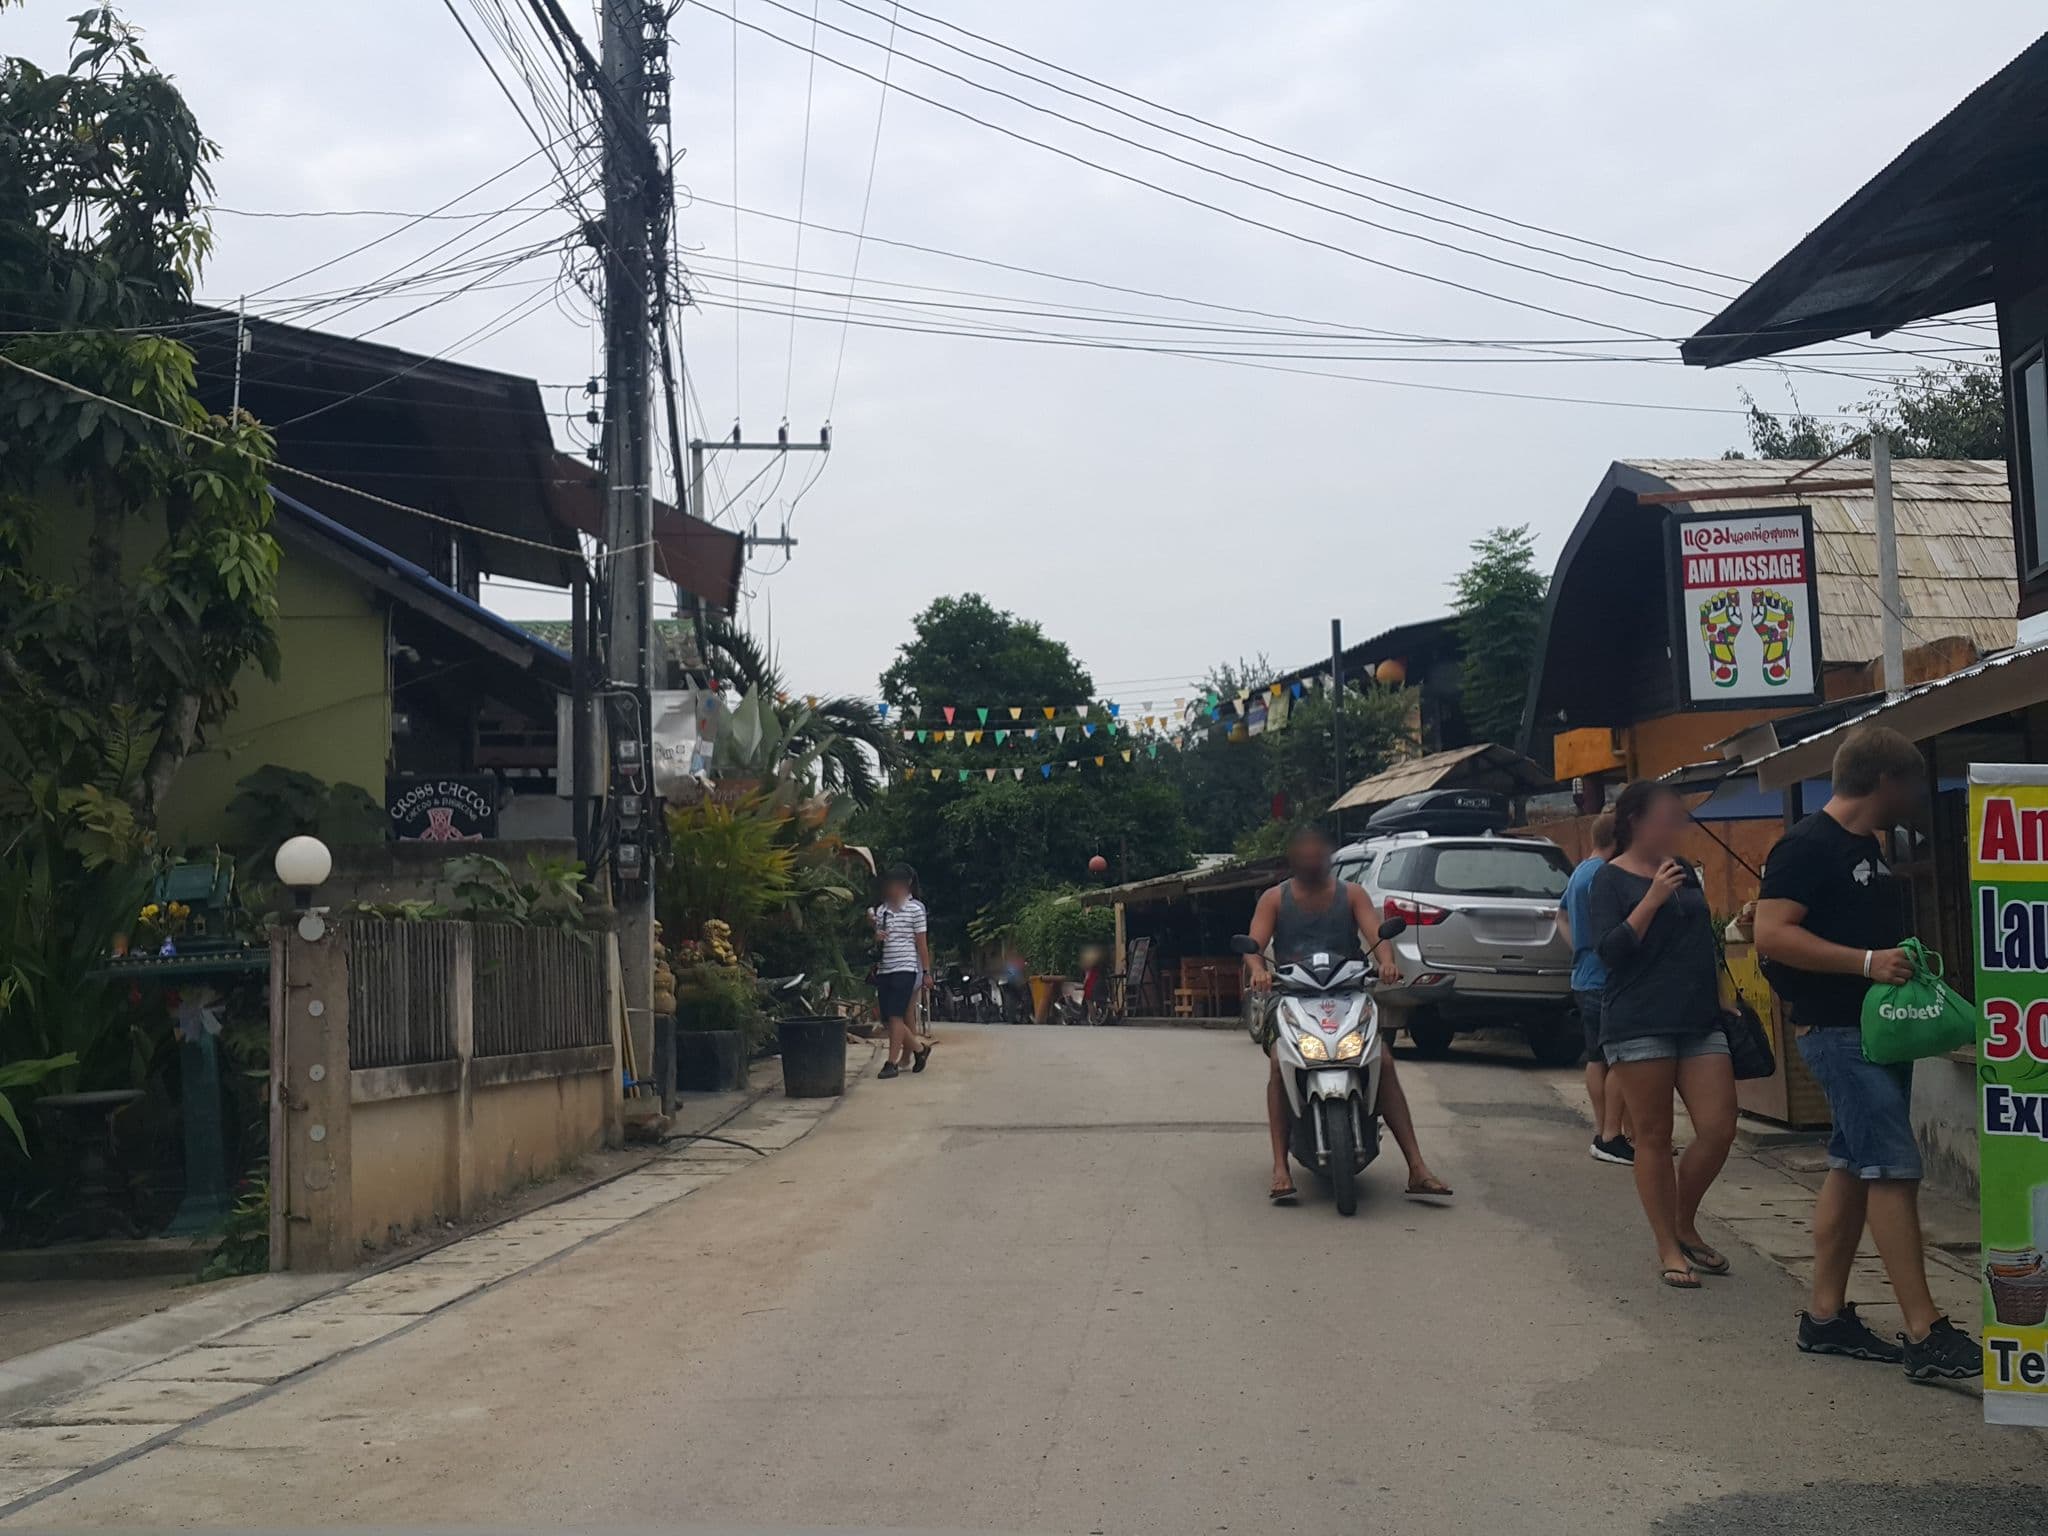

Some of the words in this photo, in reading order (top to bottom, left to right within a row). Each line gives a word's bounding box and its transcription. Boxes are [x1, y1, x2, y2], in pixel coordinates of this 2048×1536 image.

[1687, 558, 1715, 584] AM
[1718, 553, 1802, 582] MASSAGE
[390, 783, 434, 818] CROSS
[1984, 998, 2048, 1061] 30
